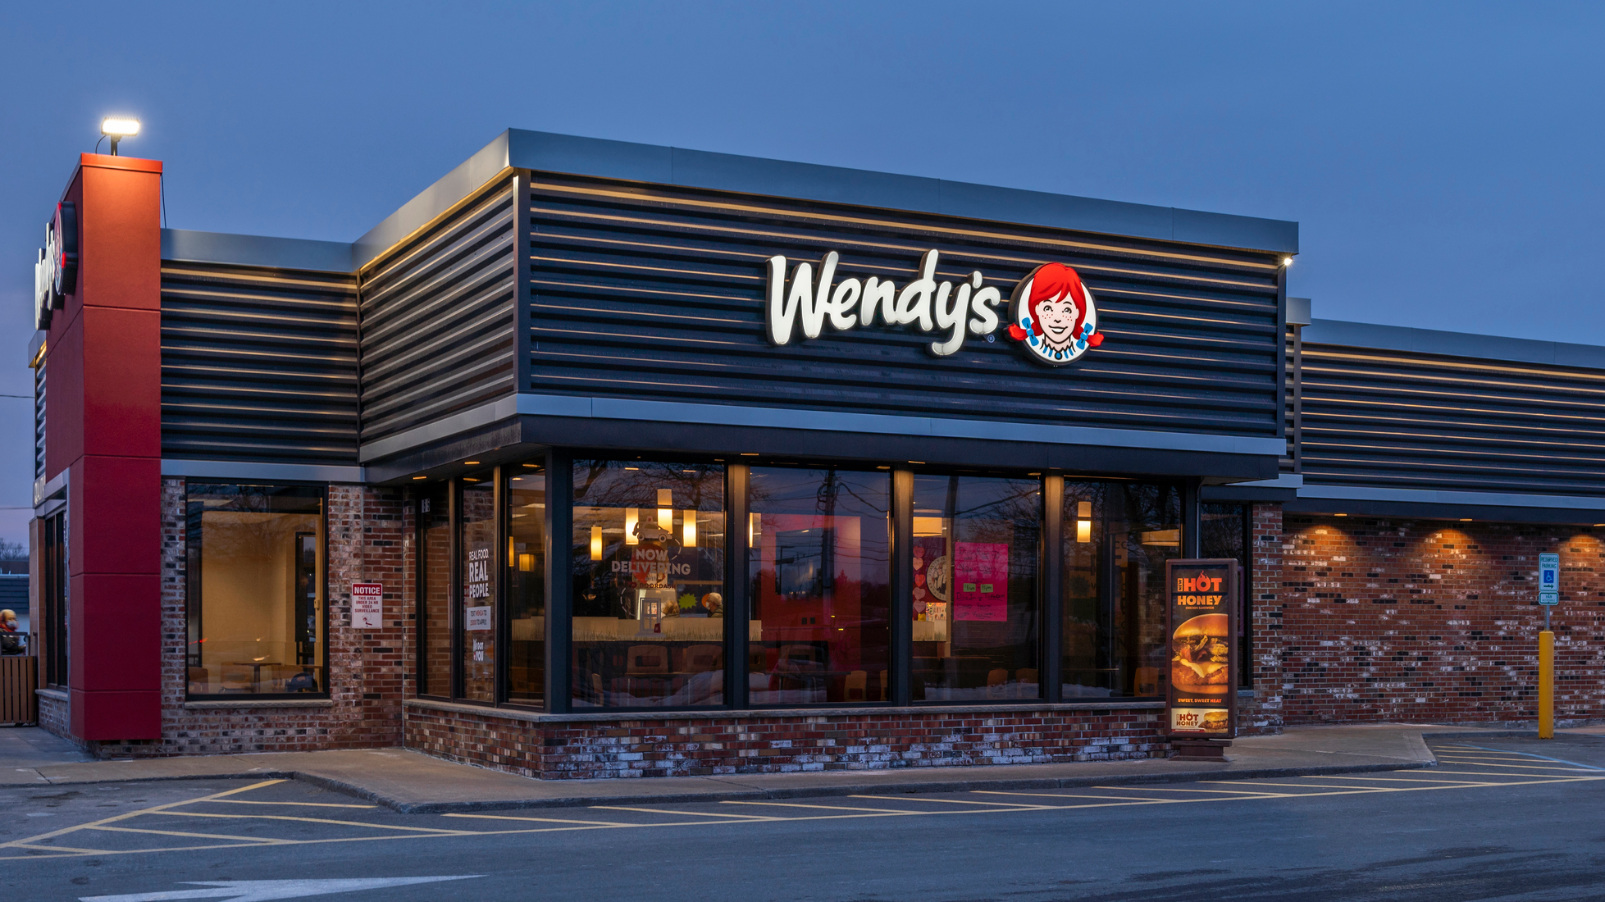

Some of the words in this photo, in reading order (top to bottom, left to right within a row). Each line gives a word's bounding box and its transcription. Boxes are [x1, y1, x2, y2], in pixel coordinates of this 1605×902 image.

[766, 249, 1001, 356] Wendy's
[469, 551, 478, 561] REAL
[636, 549, 668, 561] NOW
[469, 561, 488, 582] REAL
[612, 561, 690, 575] DELIVERING
[1183, 570, 1222, 592] HOT
[1178, 595, 1222, 605] HONEY
[1179, 711, 1199, 721] HOT
